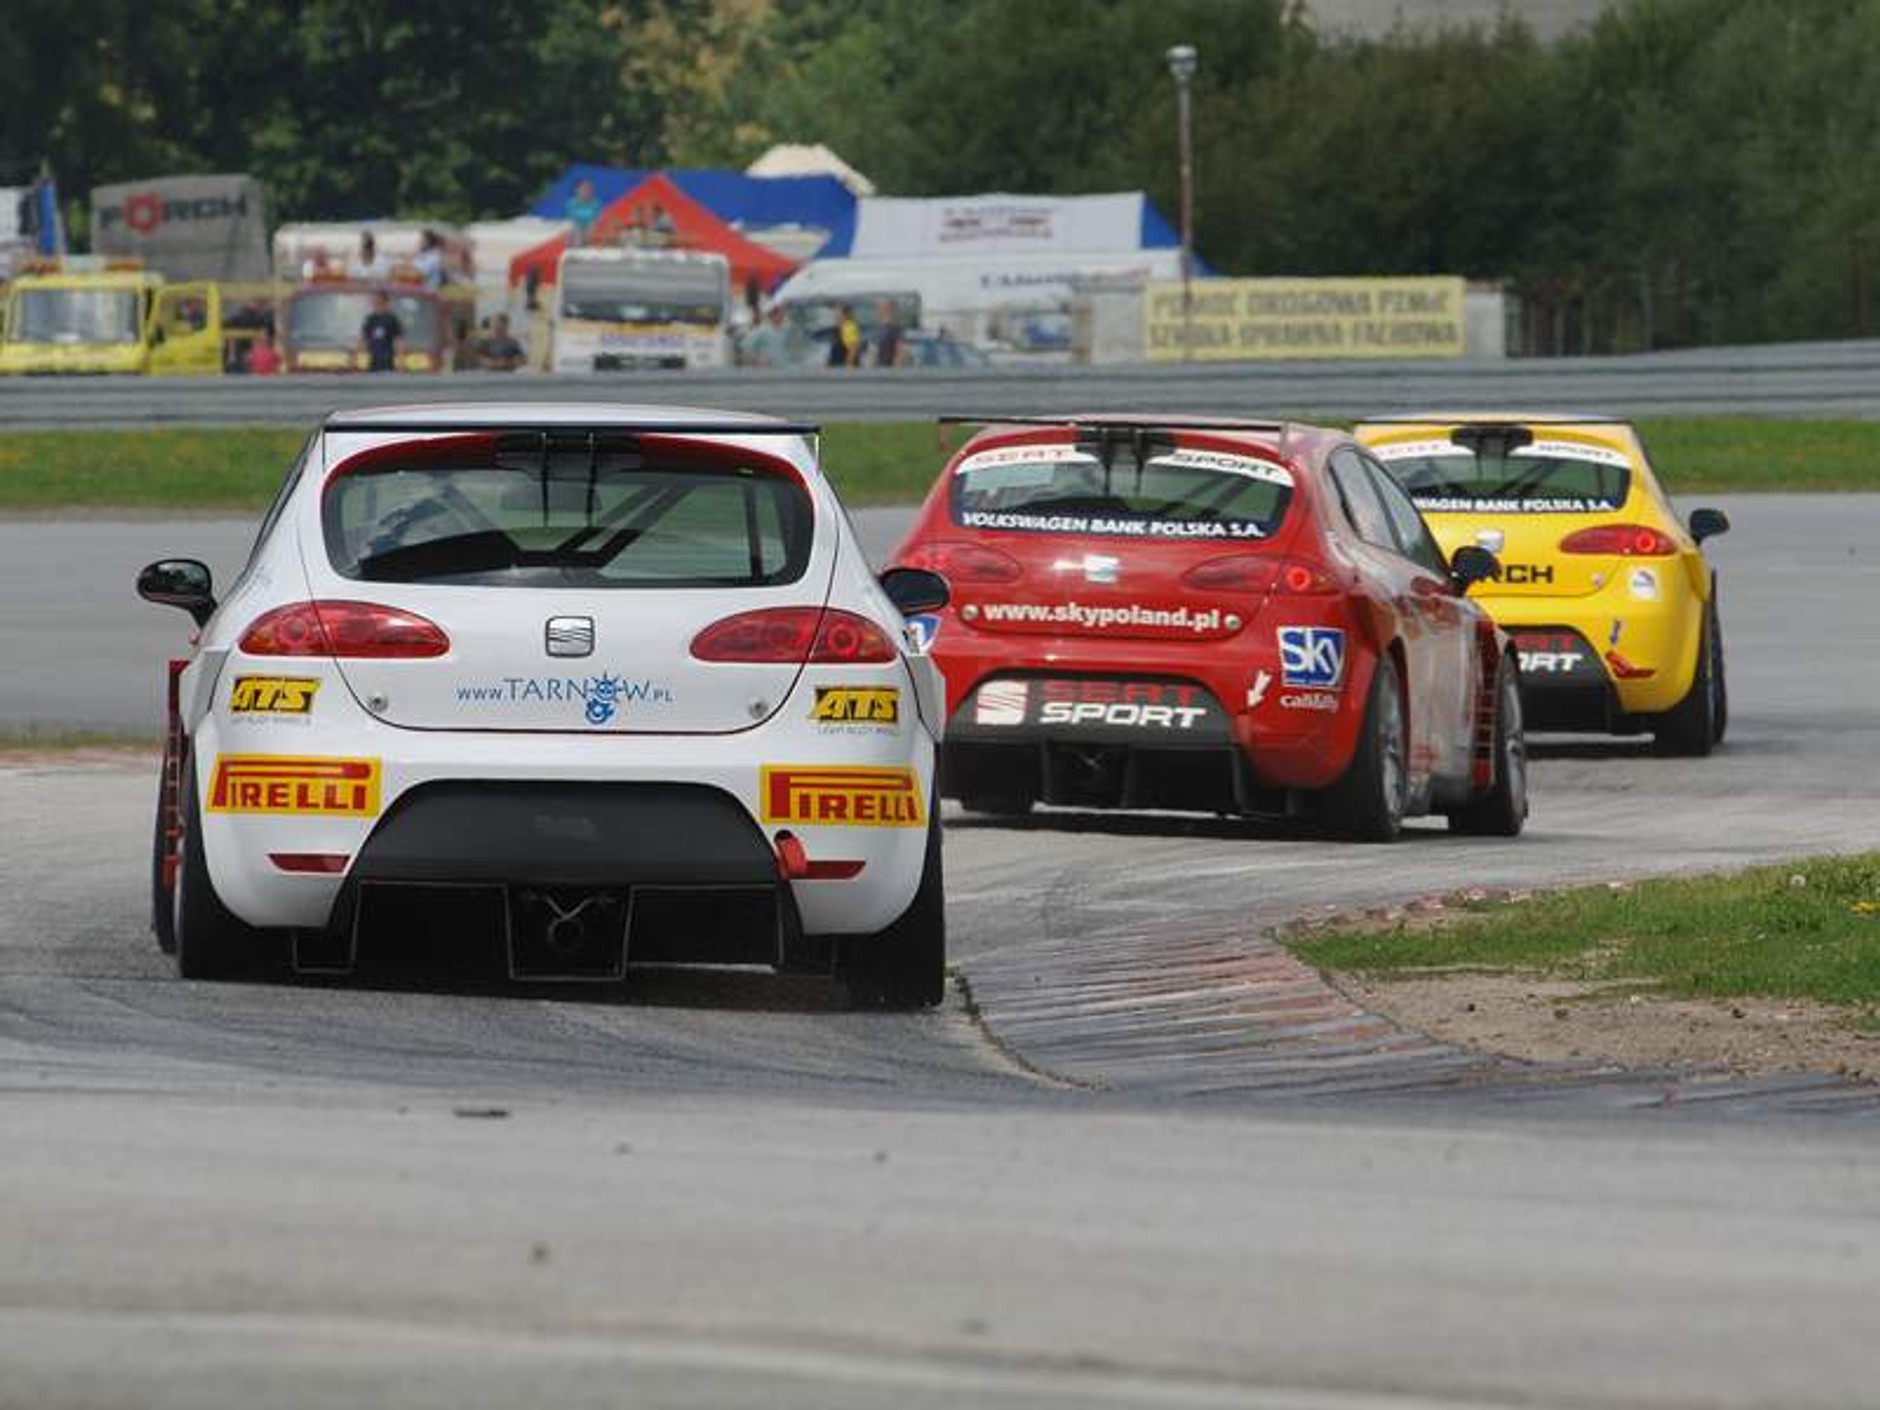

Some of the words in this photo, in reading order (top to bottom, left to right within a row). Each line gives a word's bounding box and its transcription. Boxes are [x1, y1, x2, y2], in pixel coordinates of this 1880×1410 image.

[1171, 452, 1281, 477] SPORT
[1475, 500, 1520, 511] BANK
[1523, 500, 1584, 512] POLSKA
[962, 512, 1088, 531] VOLKSWAGEN
[1090, 519, 1146, 535] BANK
[1150, 521, 1226, 537] POLSKA
[983, 602, 1222, 632] www.skypoland.pl
[231, 677, 321, 712] ATS
[812, 687, 899, 722] ATS
[1044, 680, 1204, 704] SEAT
[1038, 702, 1207, 728] SPORT
[212, 760, 371, 810] PIRELLI
[769, 771, 918, 821] PIRELLI
